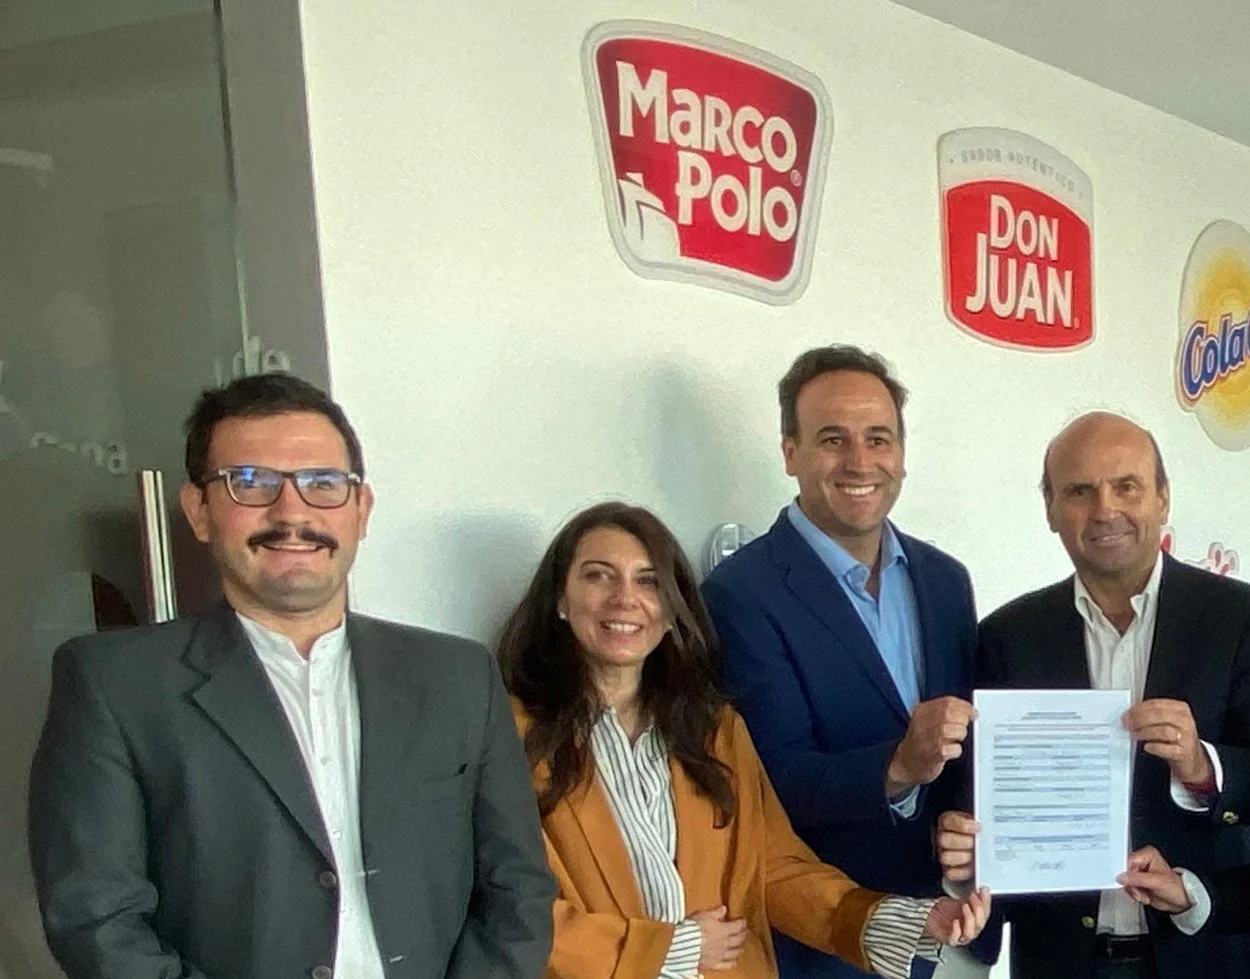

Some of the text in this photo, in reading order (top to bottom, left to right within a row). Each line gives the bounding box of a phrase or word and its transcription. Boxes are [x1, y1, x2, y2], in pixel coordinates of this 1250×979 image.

[675, 150, 797, 242] Polo
[990, 194, 1058, 261] DON
[966, 233, 1074, 328] JUAN
